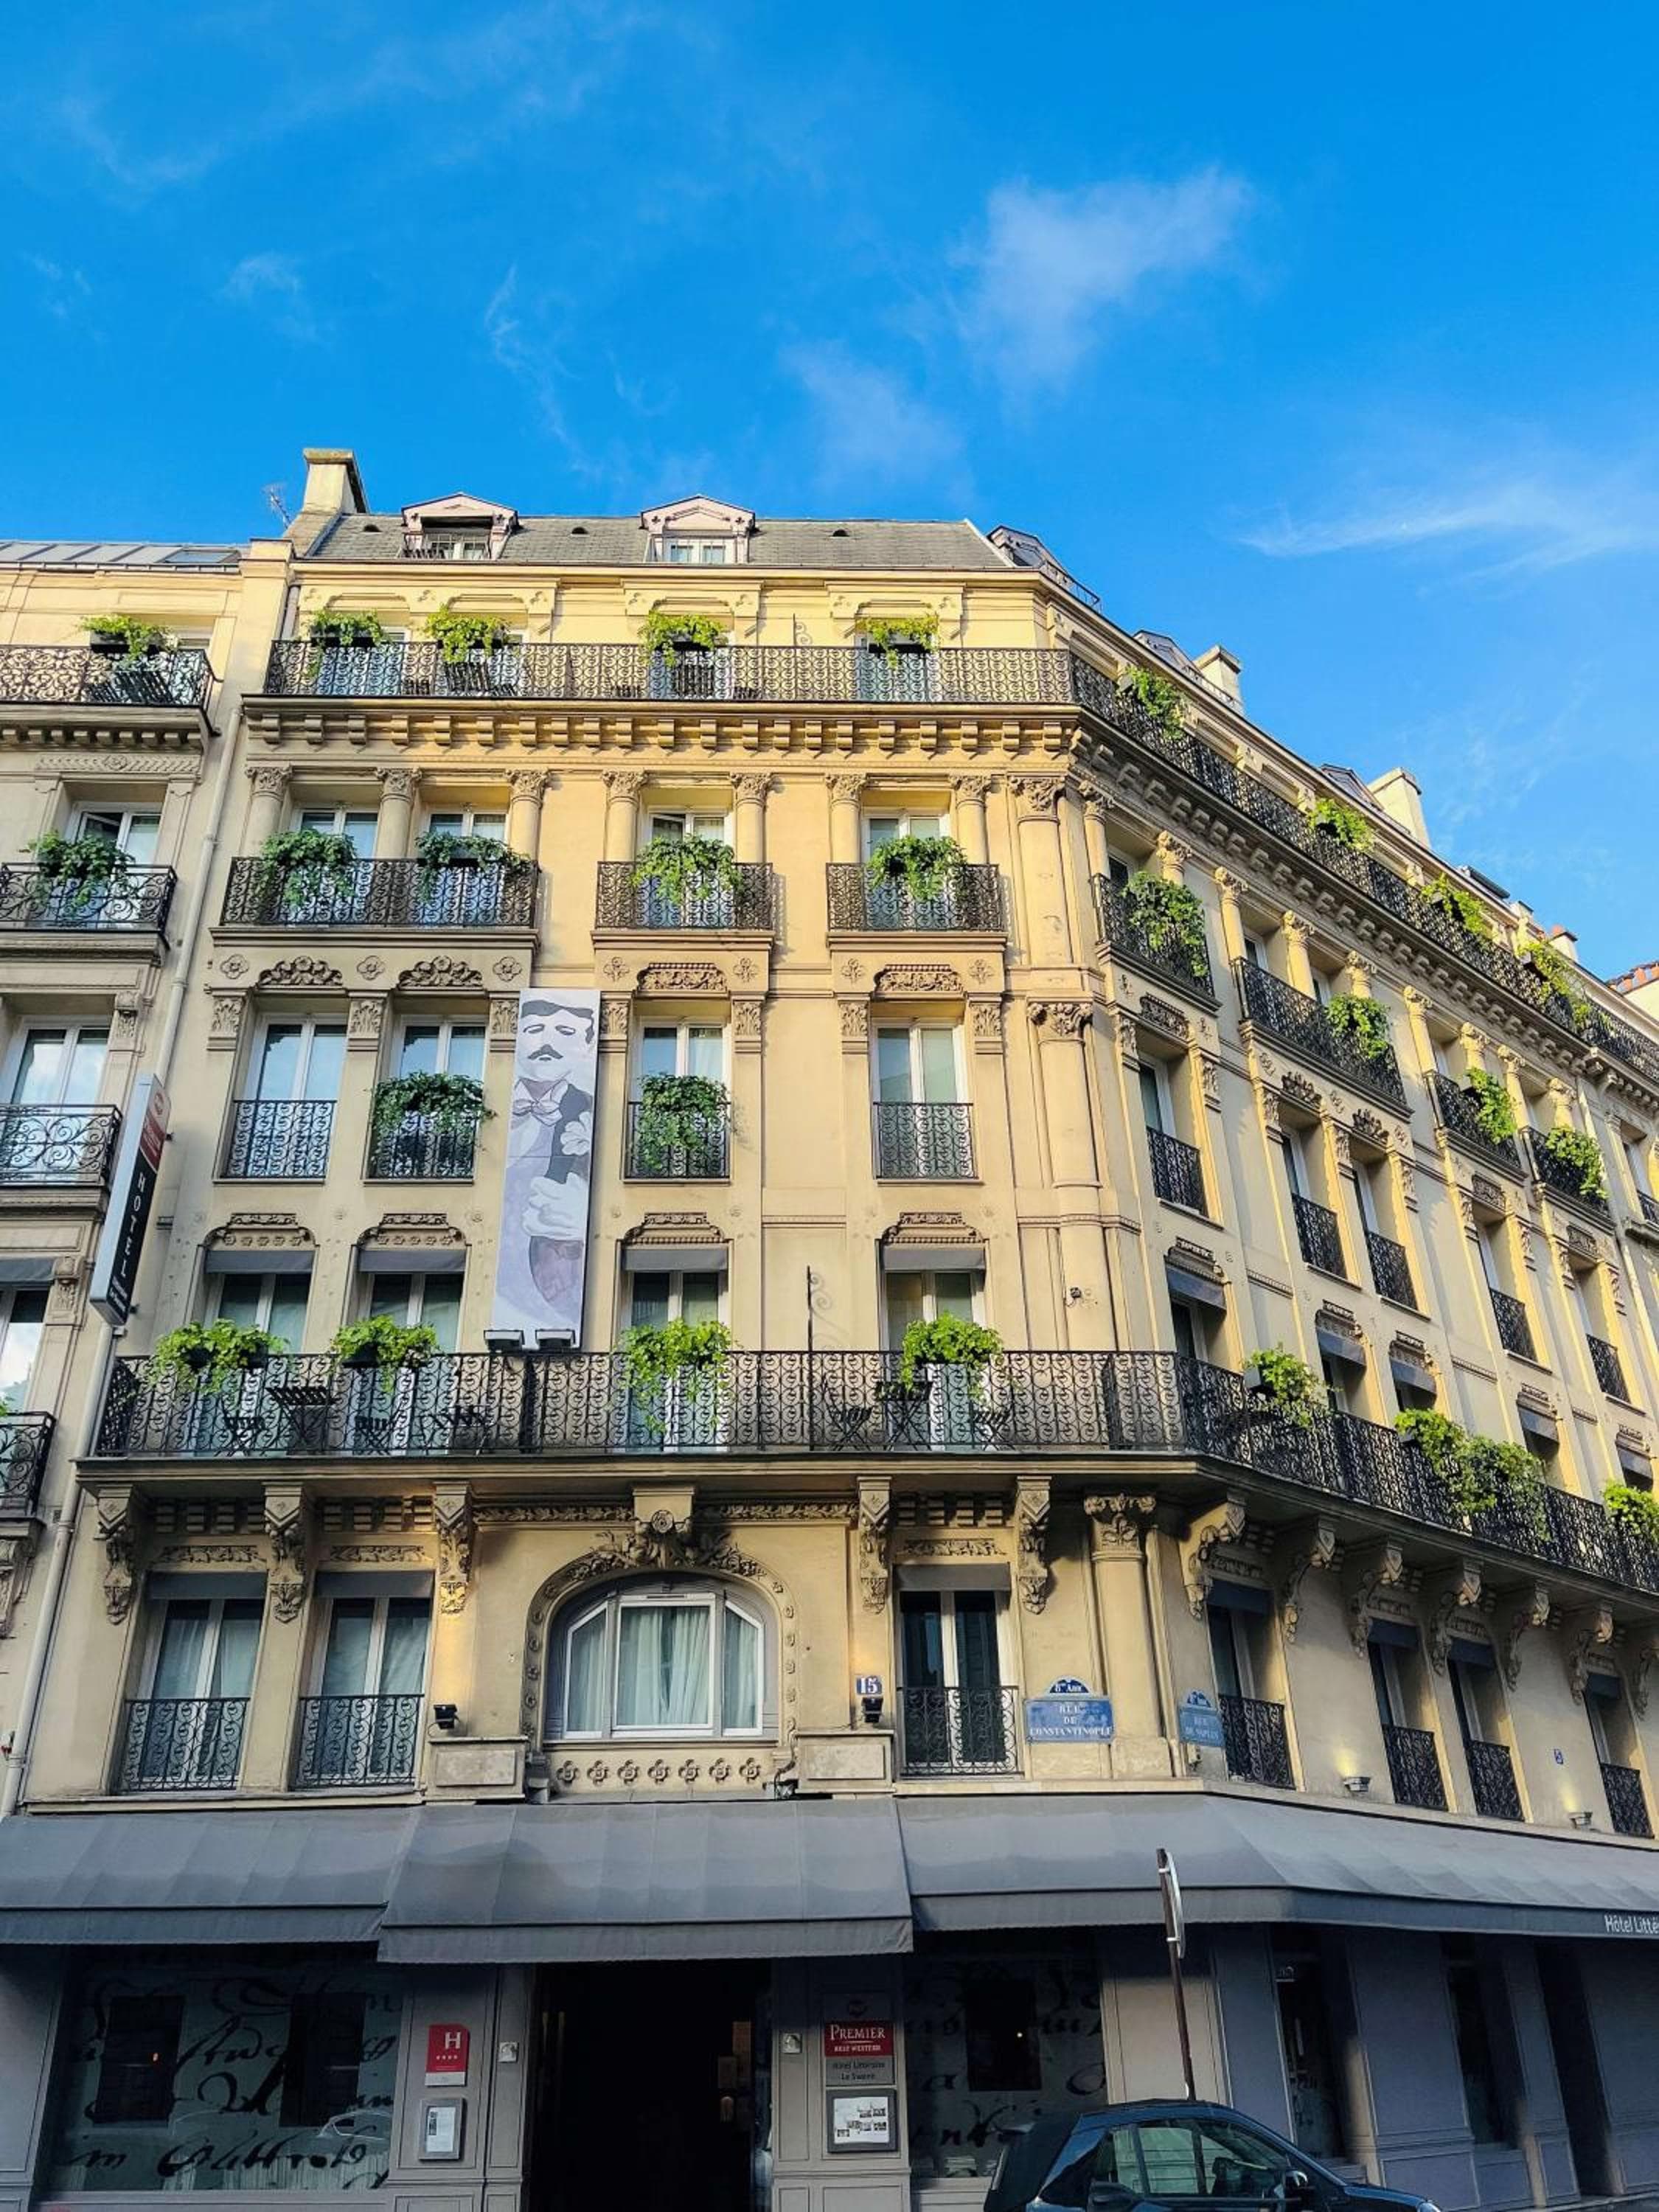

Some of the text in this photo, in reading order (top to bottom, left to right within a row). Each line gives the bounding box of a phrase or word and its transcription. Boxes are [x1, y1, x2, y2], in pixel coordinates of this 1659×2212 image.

[860, 1677, 878, 1694] 15
[1060, 1705, 1080, 1714] RUE
[1064, 1717, 1077, 1725] DE
[1029, 1727, 1111, 1736] CONSTANTINOPLE
[830, 2024, 886, 2041] PREMIER
[445, 2031, 462, 2050] H
